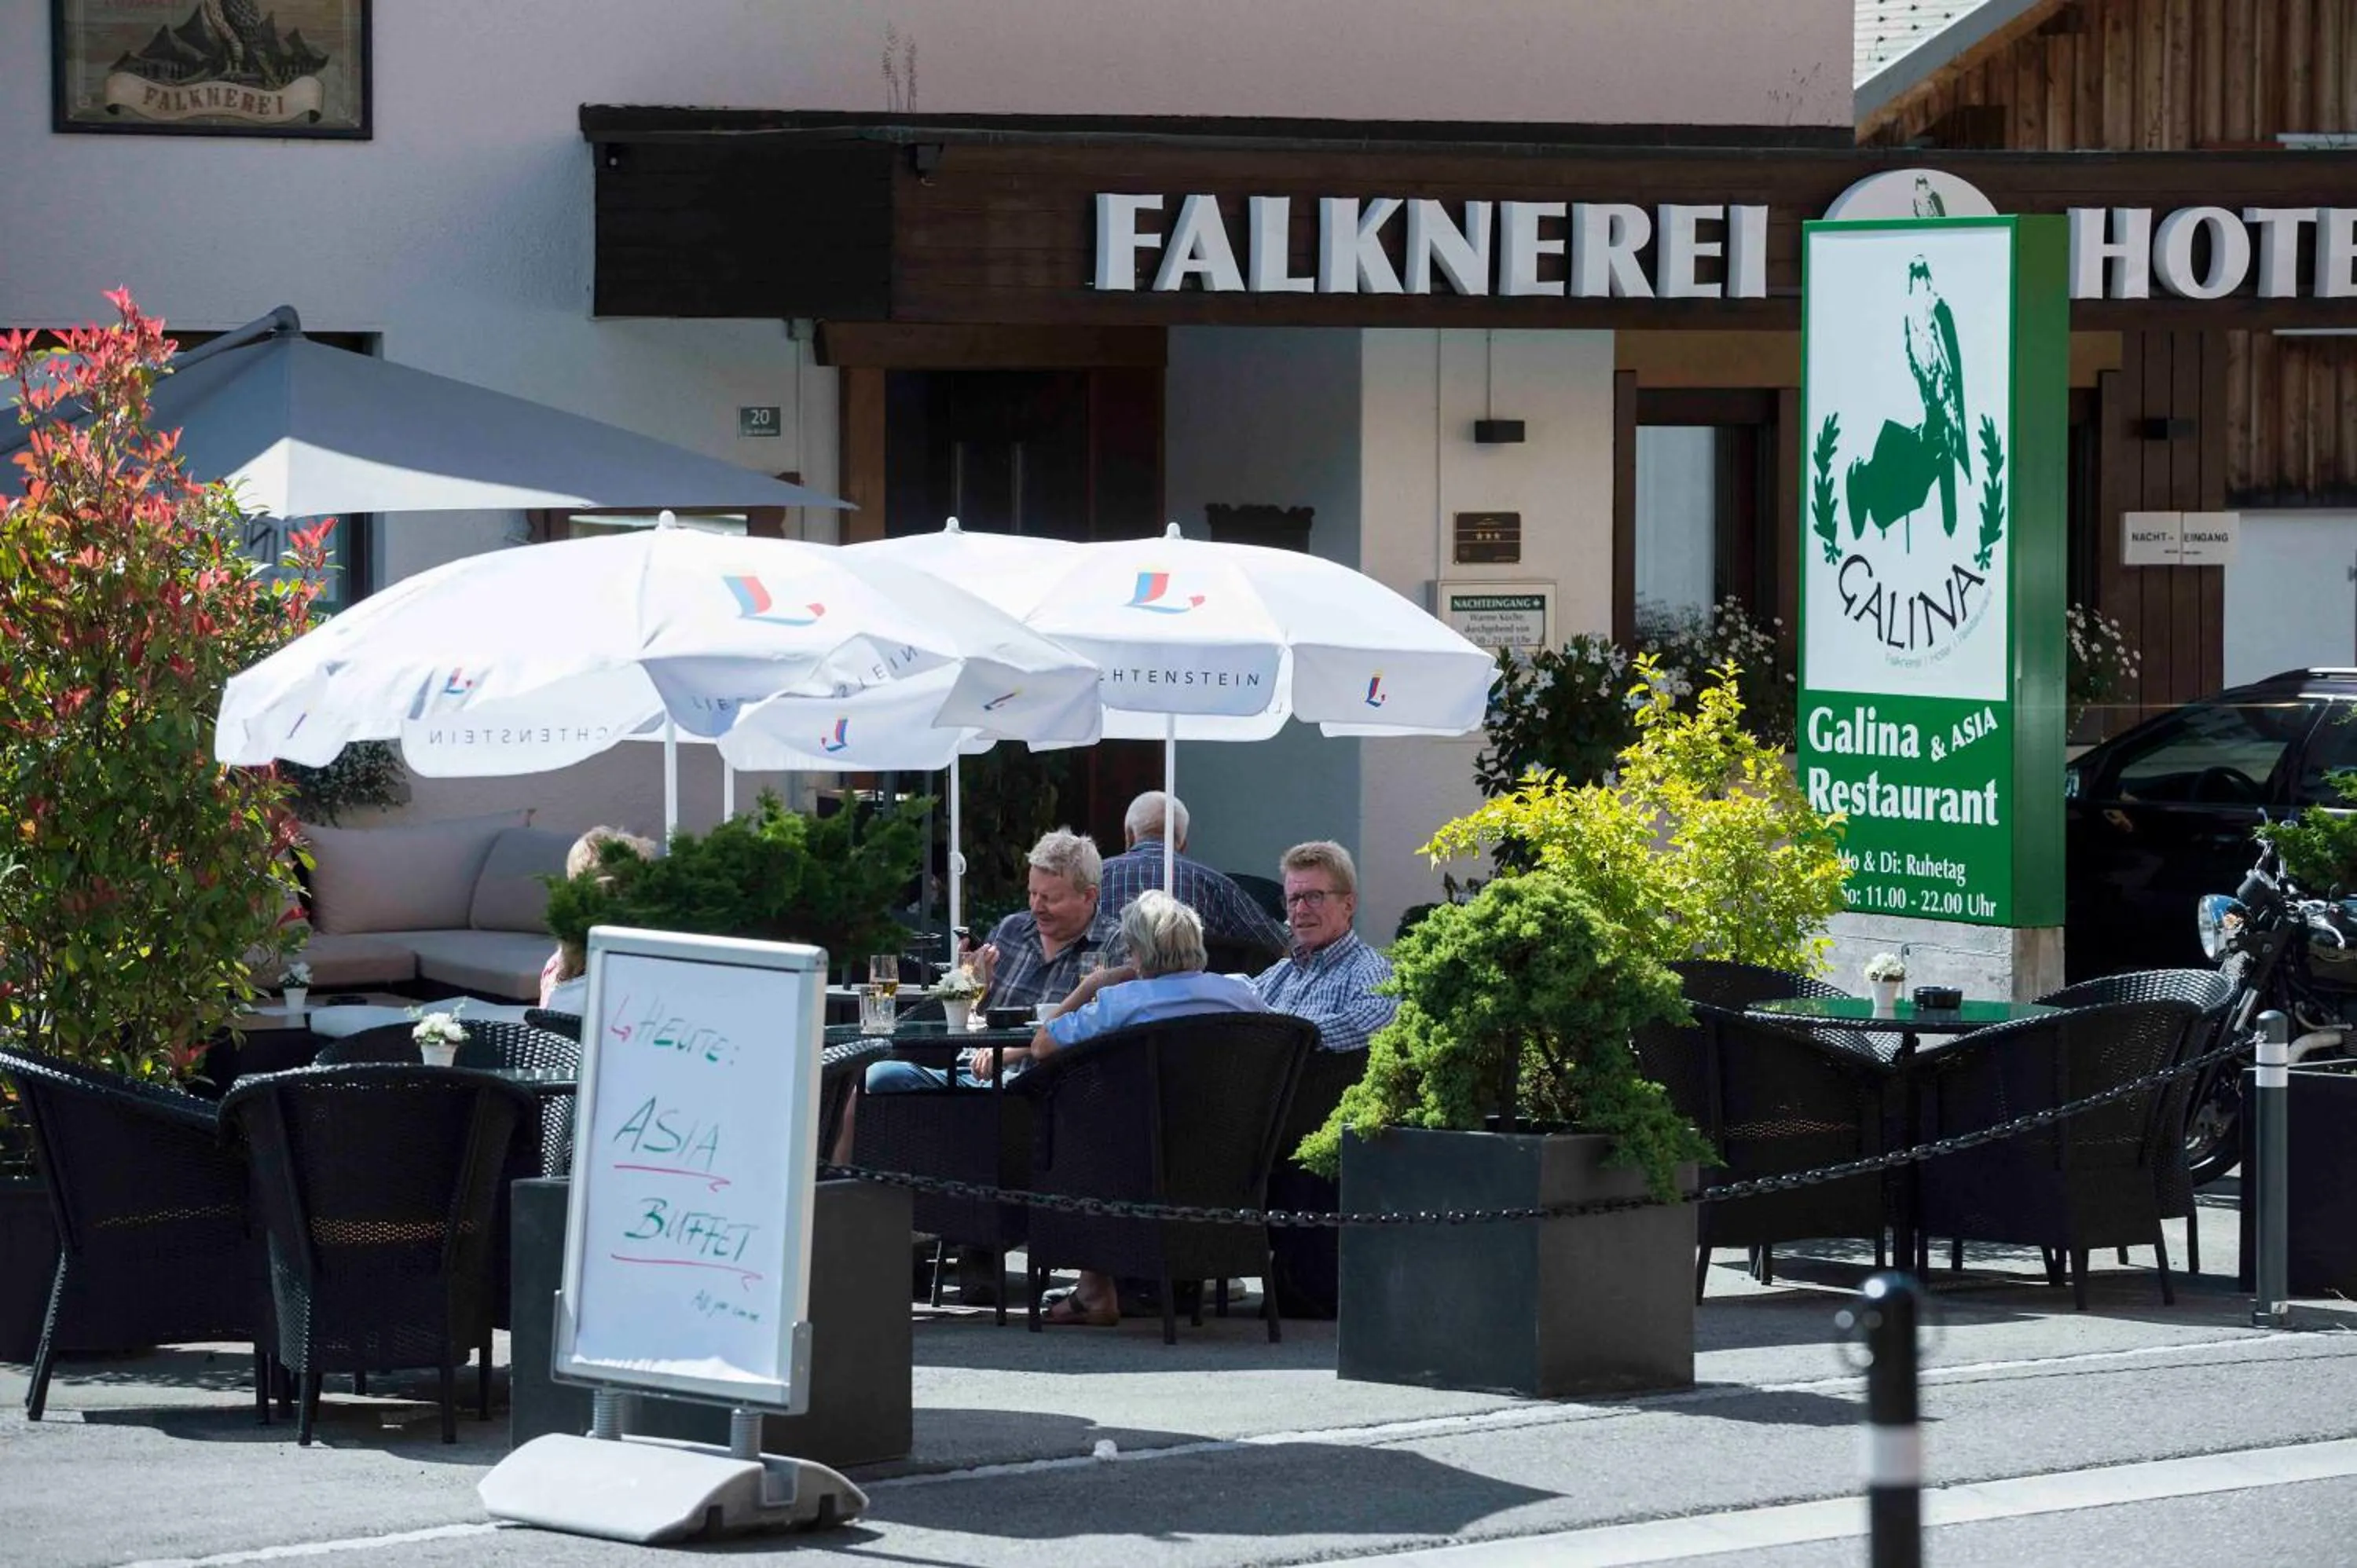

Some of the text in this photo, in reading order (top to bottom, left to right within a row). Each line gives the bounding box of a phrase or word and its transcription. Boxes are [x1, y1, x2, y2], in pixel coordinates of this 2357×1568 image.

[142, 86, 284, 115] FALKNEREI
[1094, 192, 1769, 299] FALKNEREI
[751, 409, 769, 425] 20
[2132, 532, 2229, 543] NACHT- EINGANG
[1453, 599, 1531, 609] NACHTEINGANG
[1838, 554, 1985, 650] GALINA
[1099, 669, 1260, 686] HTENSTEIN
[1808, 706, 1999, 762] Galina & ASIA
[1808, 767, 2000, 826] Restaurant
[1863, 850, 1876, 873] &
[1879, 850, 1902, 874] Di:
[1906, 853, 1967, 887] Ruhetag
[1866, 885, 1906, 909] 11.00
[1921, 889, 1963, 914] 22.00
[1967, 892, 1997, 918] Uhr
[614, 1096, 719, 1168] ASIA
[624, 1197, 760, 1262] BUFFET
